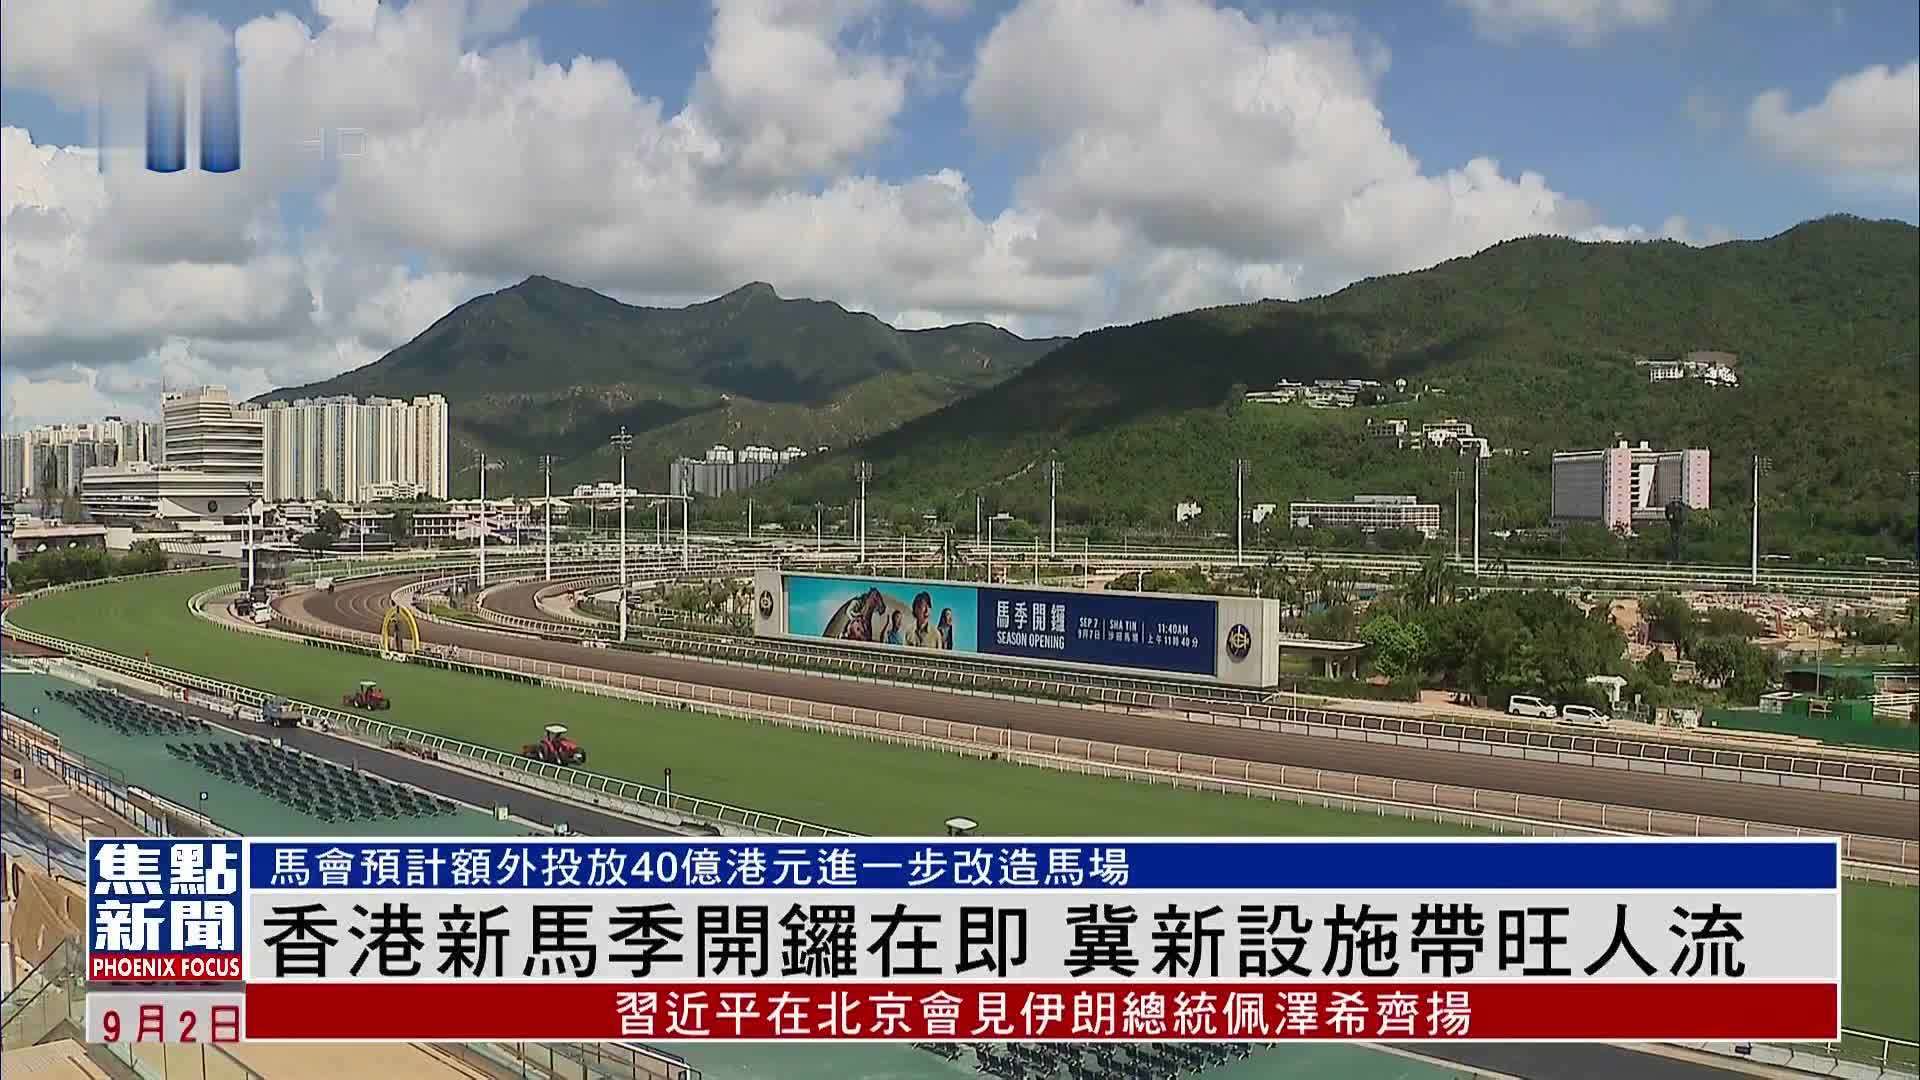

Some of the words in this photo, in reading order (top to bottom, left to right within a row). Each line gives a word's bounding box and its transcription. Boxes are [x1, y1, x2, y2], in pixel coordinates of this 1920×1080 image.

[996, 599, 1066, 633] 馬季開鑼
[1079, 617, 1093, 629] SEP
[1109, 619, 1124, 631] SHA
[1125, 620, 1137, 632] TIN
[1157, 623, 1189, 636] 11:40AM
[996, 630, 1028, 648] SEASON
[1028, 632, 1065, 651] OPENING
